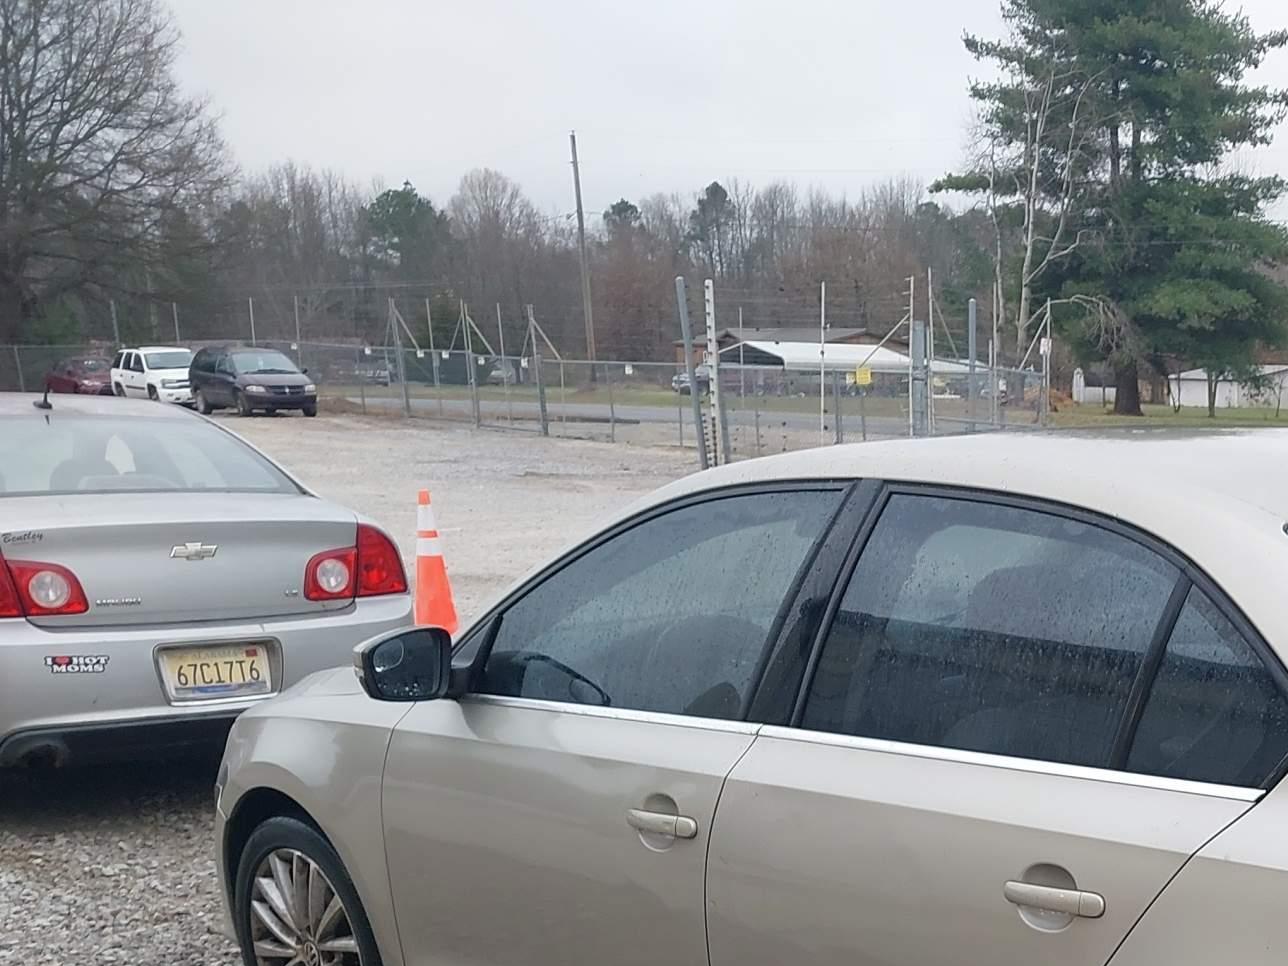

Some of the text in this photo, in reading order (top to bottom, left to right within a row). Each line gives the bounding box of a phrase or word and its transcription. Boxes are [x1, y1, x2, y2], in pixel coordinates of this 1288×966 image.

[2, 531, 43, 543] Bentley
[71, 655, 109, 665] HOT
[52, 664, 105, 673] MOMS
[177, 660, 260, 686] 67C17T6
